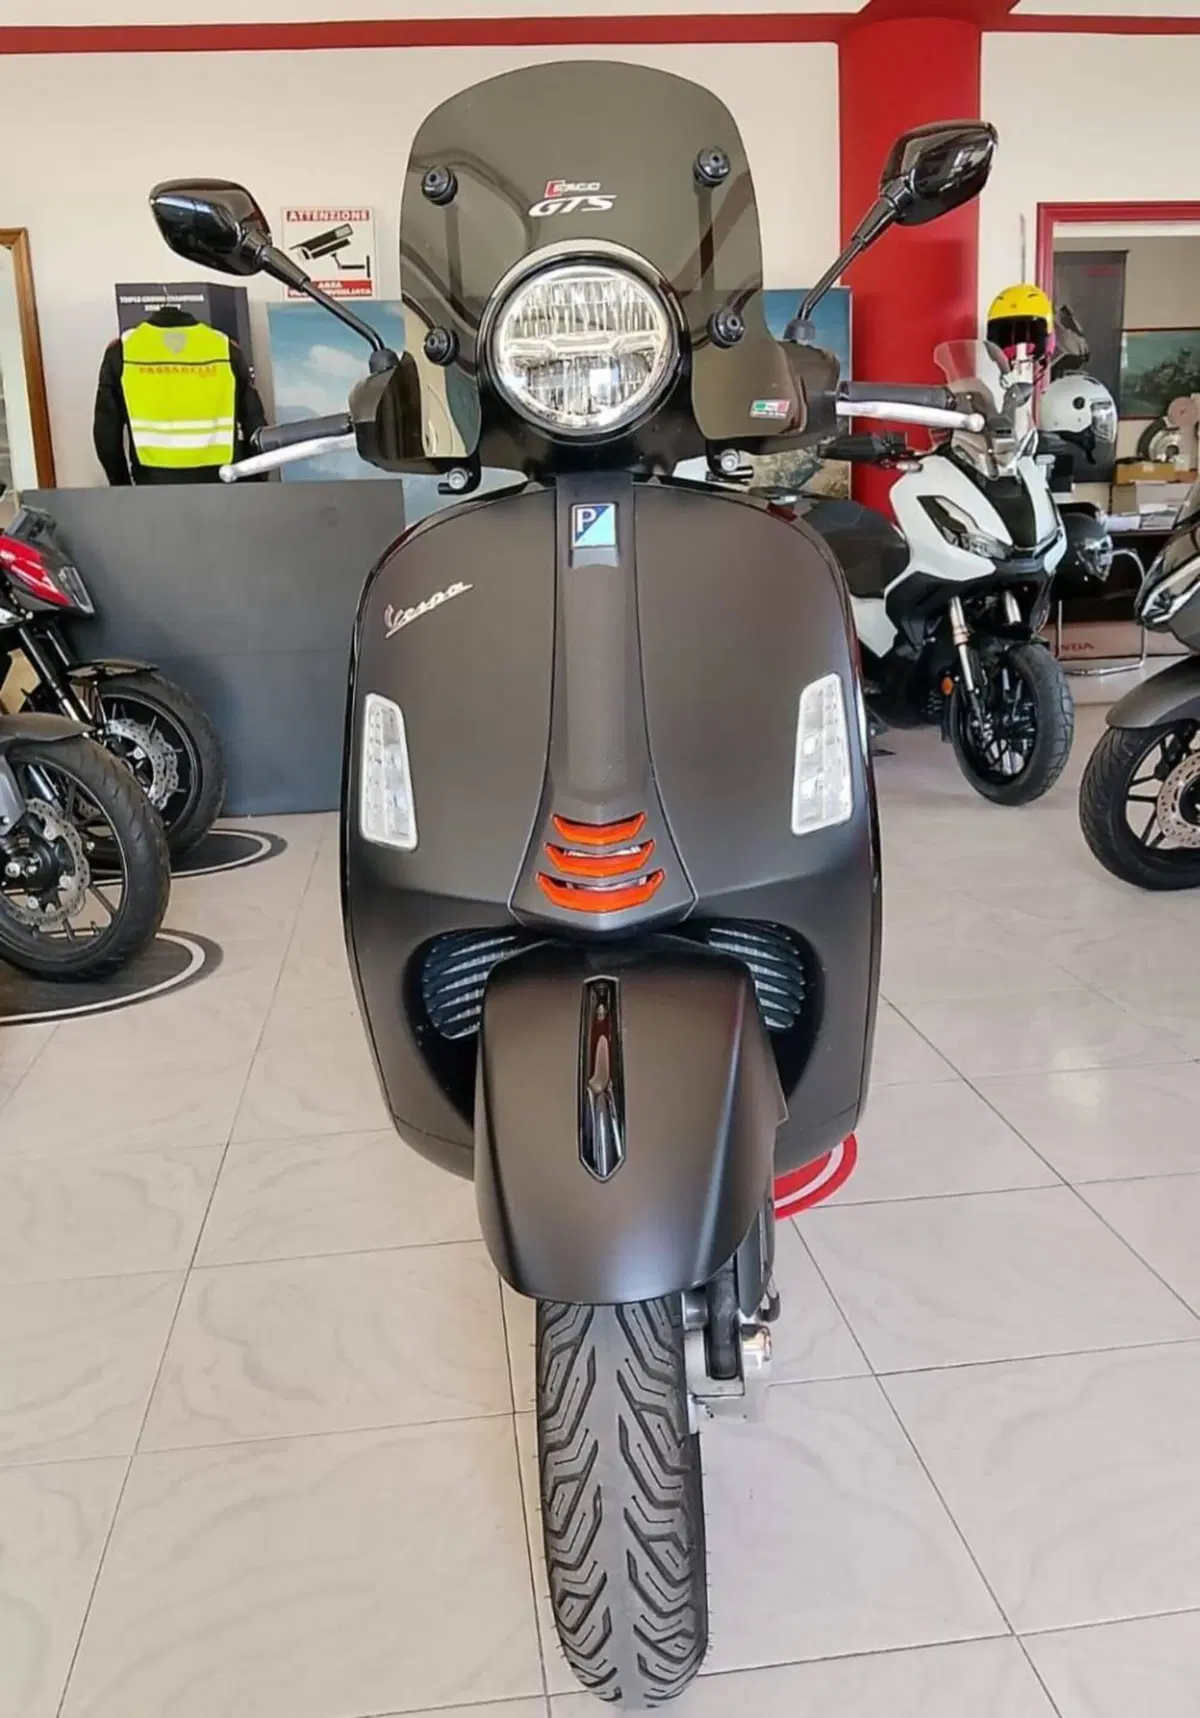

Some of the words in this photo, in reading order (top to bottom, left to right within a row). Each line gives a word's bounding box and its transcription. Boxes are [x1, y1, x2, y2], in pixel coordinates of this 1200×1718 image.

[287, 210, 369, 221] ATTENZIONE
[528, 195, 617, 217] GTS
[577, 509, 597, 532] P
[384, 582, 473, 638] Vespa
